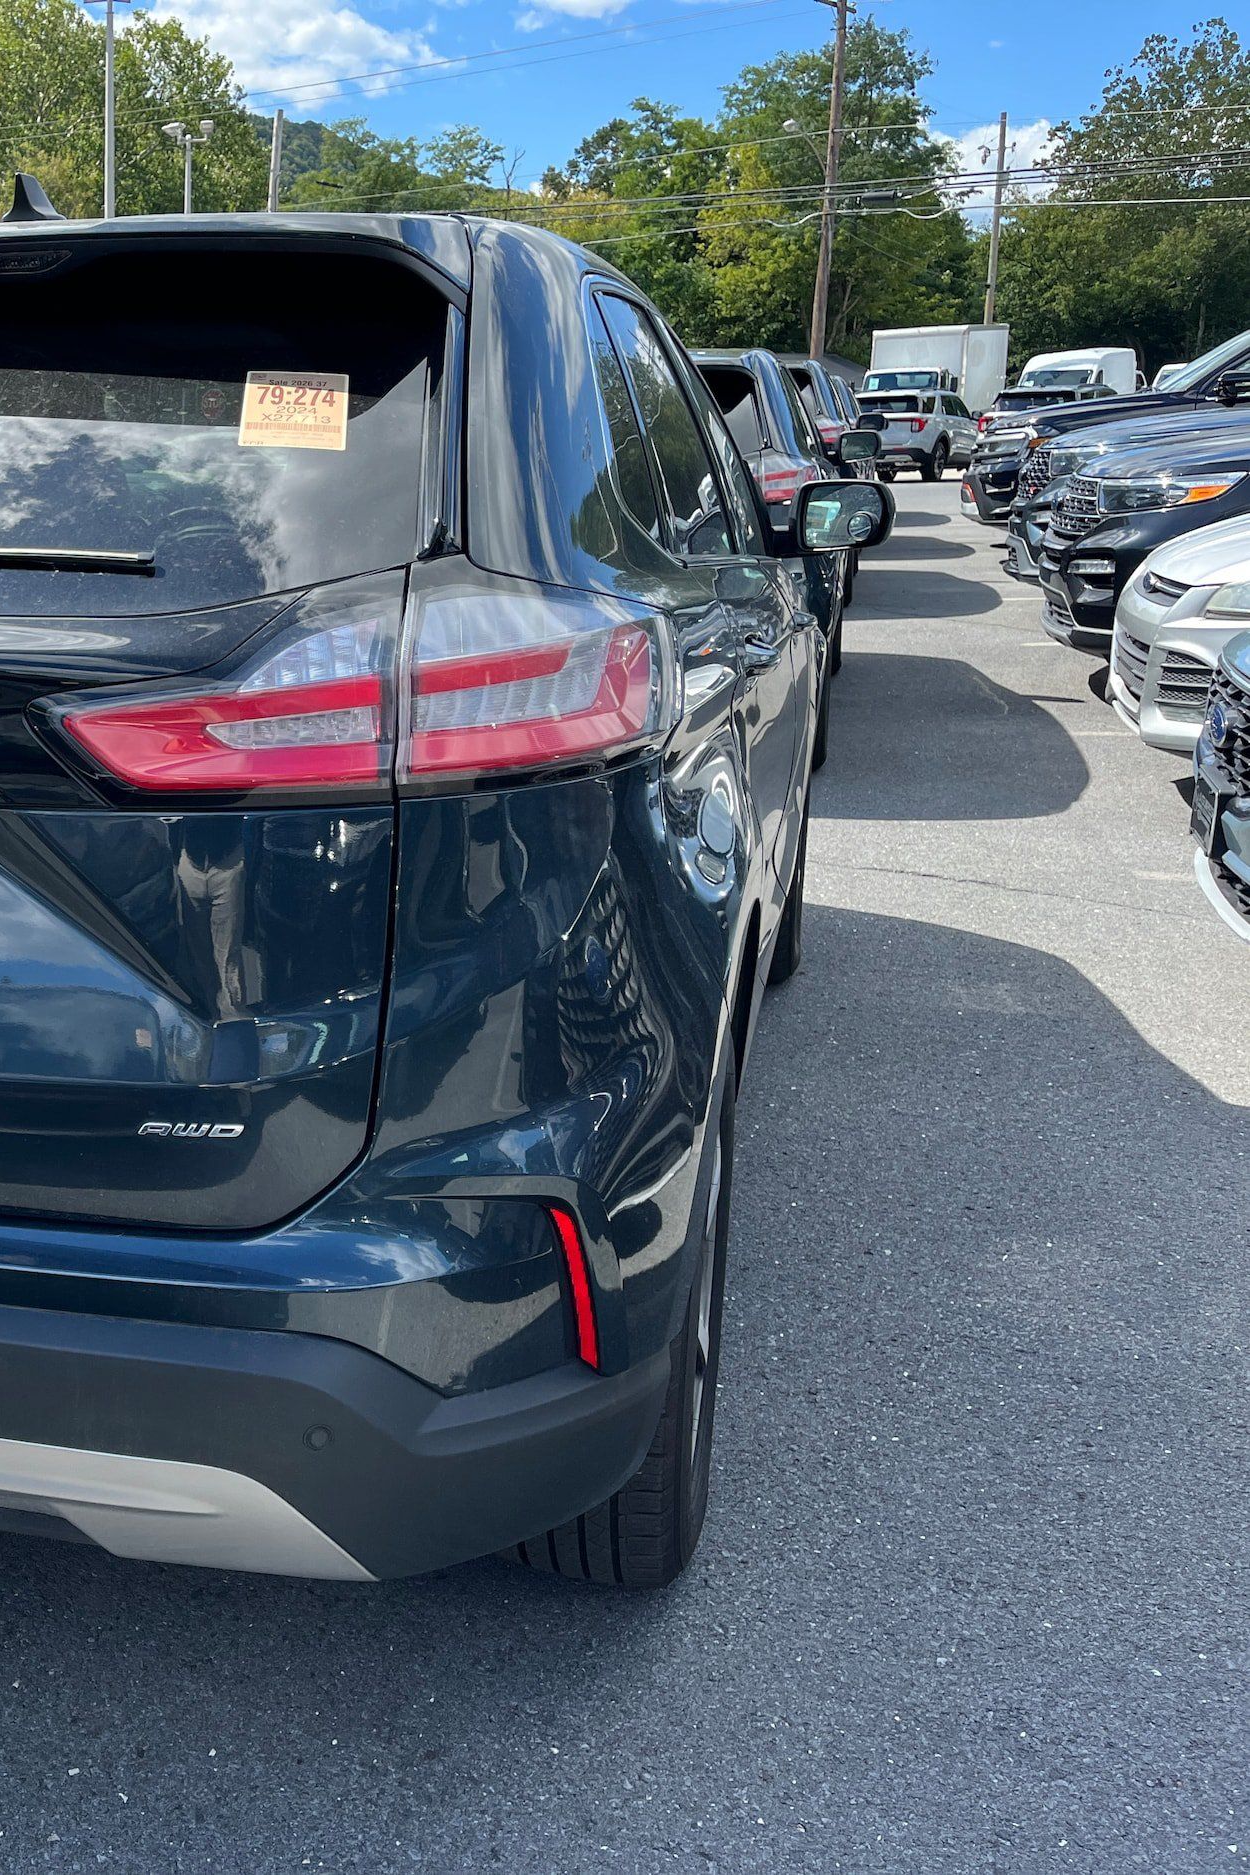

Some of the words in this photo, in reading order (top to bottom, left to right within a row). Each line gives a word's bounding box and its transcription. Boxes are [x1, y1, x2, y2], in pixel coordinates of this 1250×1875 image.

[269, 379, 288, 387] Sale
[257, 386, 336, 408] 79:274
[276, 405, 318, 414] 2024
[137, 1122, 245, 1138] AWD
